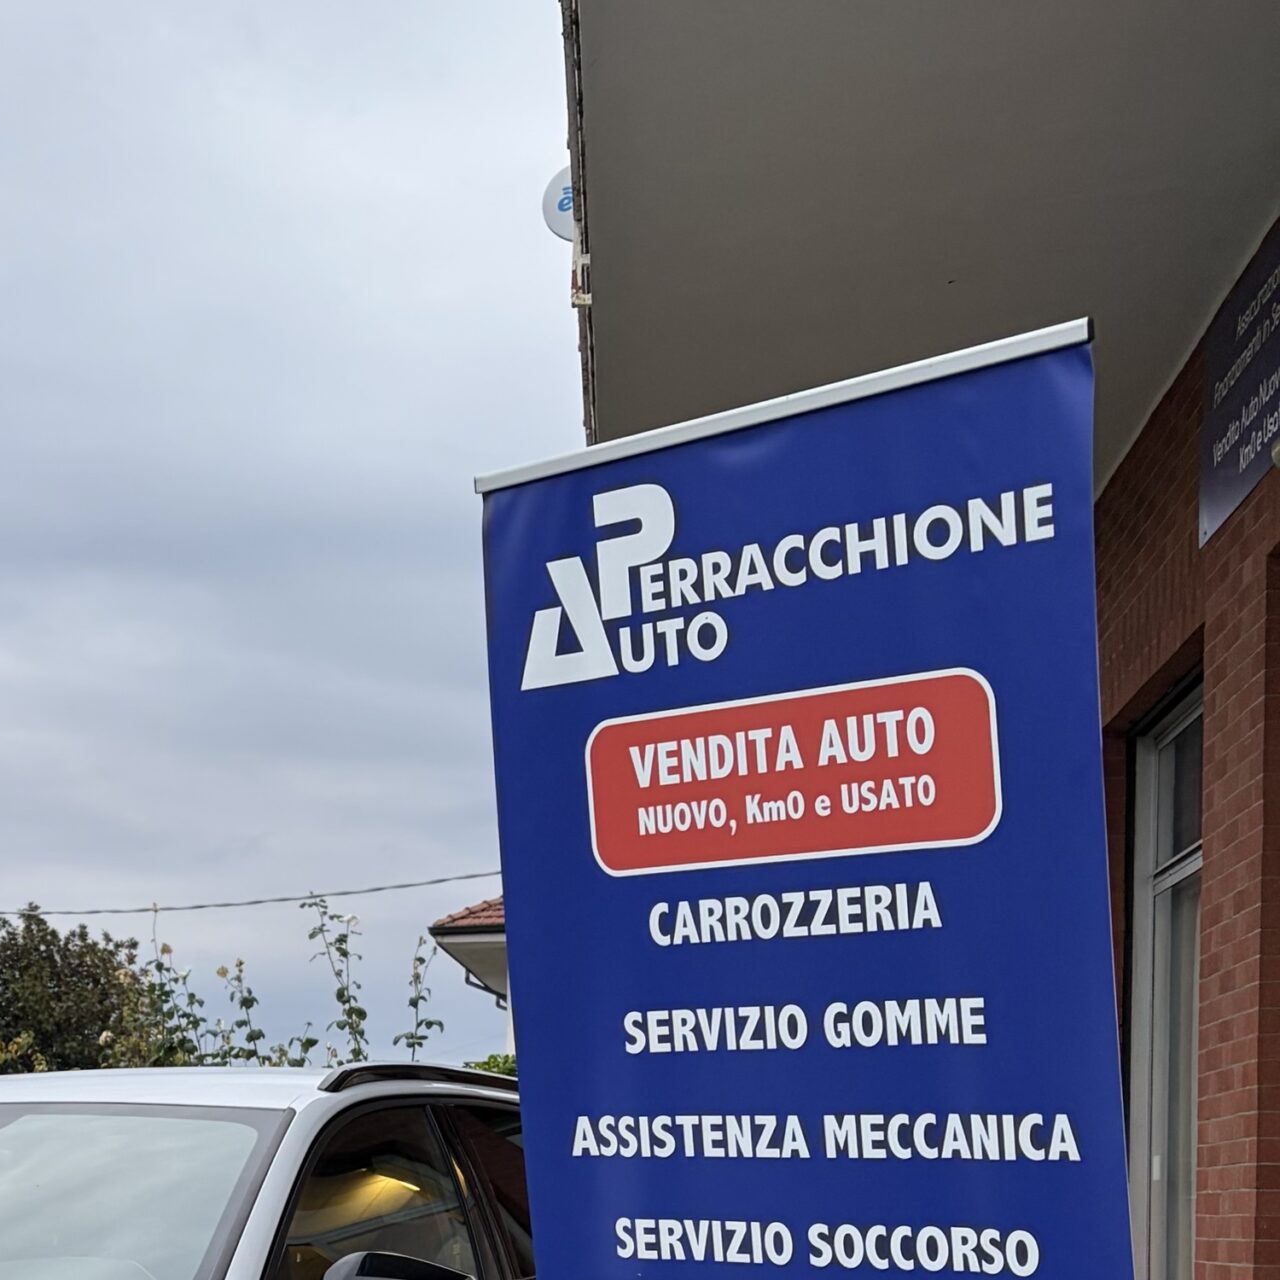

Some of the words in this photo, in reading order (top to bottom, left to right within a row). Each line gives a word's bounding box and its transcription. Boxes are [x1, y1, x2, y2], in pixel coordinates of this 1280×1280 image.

[1213, 419, 1240, 468] Vendita
[1240, 395, 1259, 434] Auto
[592, 482, 1055, 621] PERRACCHIONE
[520, 556, 728, 691] AUTO
[628, 724, 805, 789] VENDITA
[817, 706, 936, 767] AUTO
[637, 794, 737, 836] NUOVO,
[745, 790, 805, 825] Km0
[814, 794, 832, 817] e
[840, 774, 936, 815] USATO
[648, 881, 943, 947] CARROZZERIA
[623, 1004, 808, 1055] SERVIZIO
[823, 997, 987, 1049] GOMME
[572, 1114, 811, 1159] ASSISTENZA
[823, 1113, 1081, 1161] MECCANICA
[615, 1217, 793, 1266] SERVIZIO
[807, 1223, 1040, 1278] SOCCORSO
